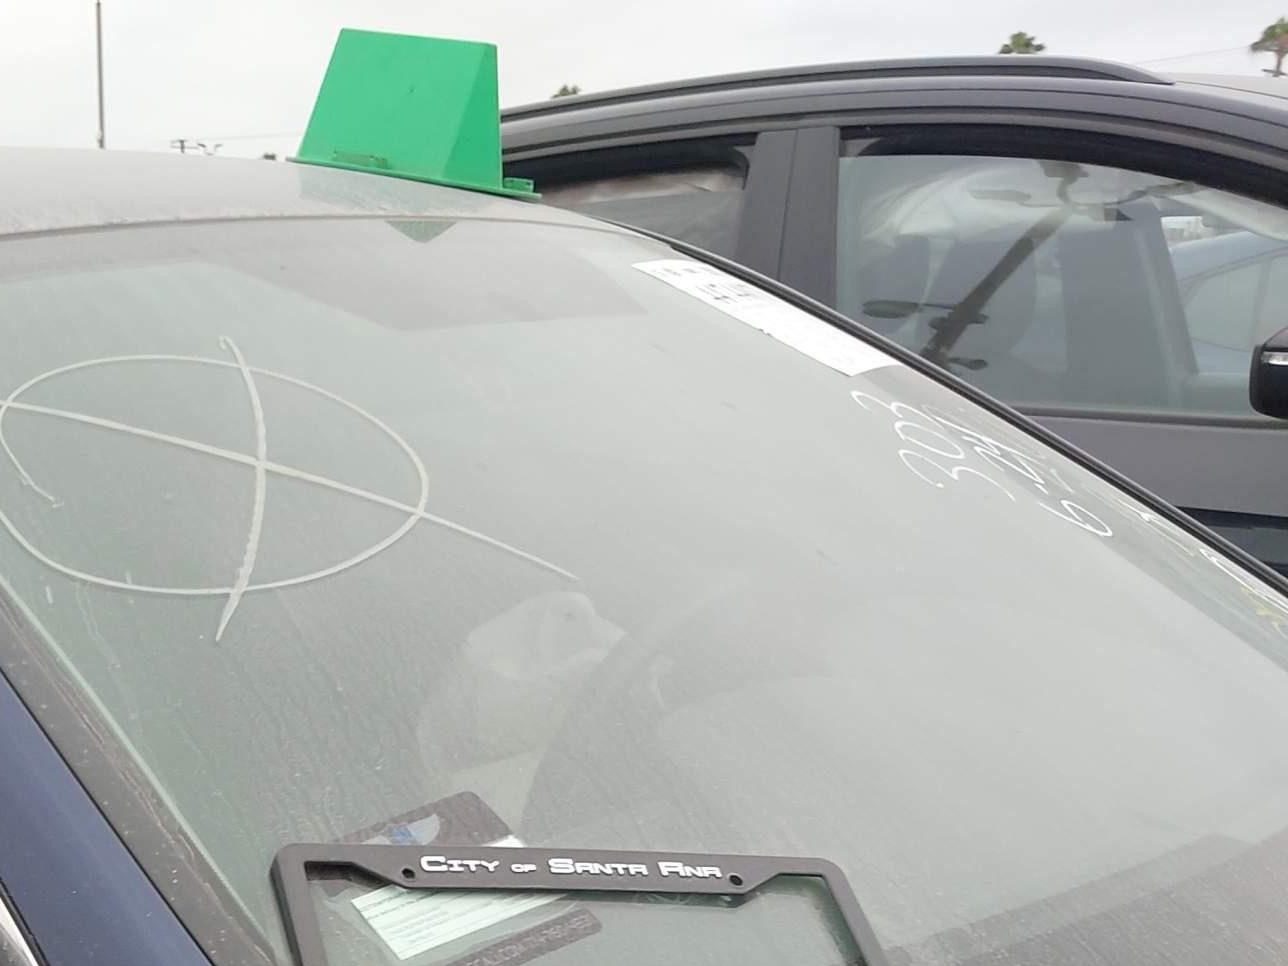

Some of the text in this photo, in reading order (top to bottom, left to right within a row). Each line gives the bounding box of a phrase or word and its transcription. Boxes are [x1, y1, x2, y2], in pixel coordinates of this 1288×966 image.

[420, 855, 724, 878] CITY OF SANTA ANA
